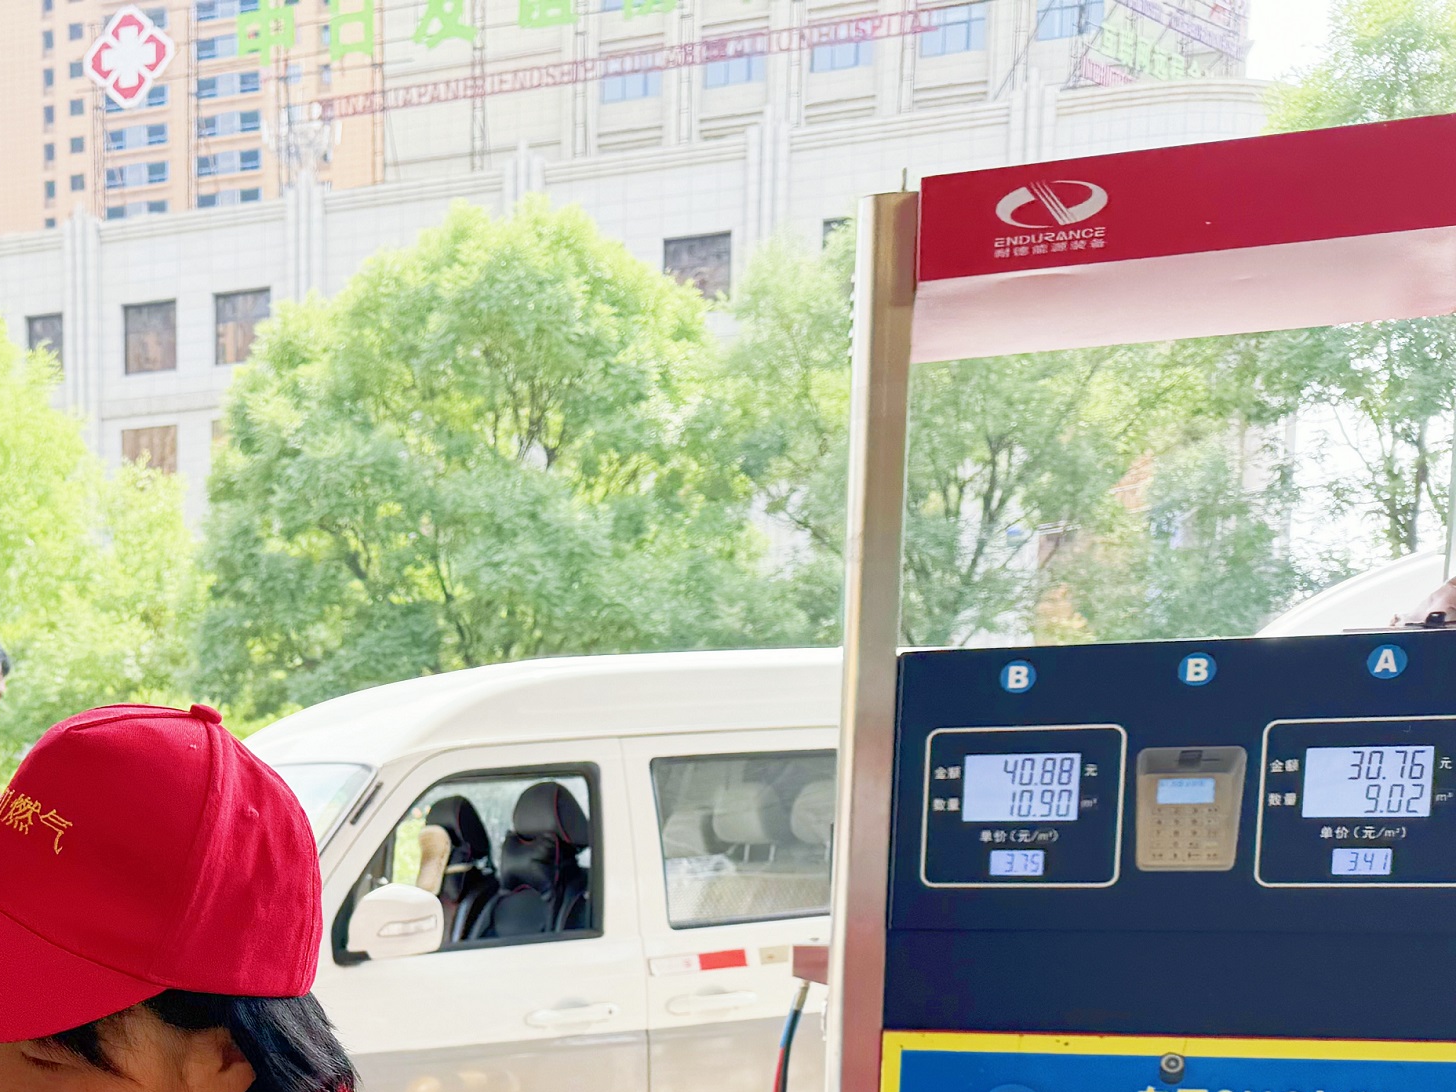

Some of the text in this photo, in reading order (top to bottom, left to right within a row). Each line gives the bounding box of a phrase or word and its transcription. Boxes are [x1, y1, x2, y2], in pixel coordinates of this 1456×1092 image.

[994, 227, 1106, 248] ENDURANCE
[1185, 657, 1209, 682] B
[1373, 649, 1398, 674] A
[1007, 666, 1029, 689] B
[934, 765, 962, 780] 金额
[1003, 757, 1075, 787] 40.88
[1084, 763, 1098, 777] 元
[1269, 758, 1300, 773] 金额
[1347, 750, 1426, 780] 30.76
[1439, 756, 1453, 770] 元
[932, 797, 960, 812] 数量
[1009, 788, 1073, 818] 10.90
[1268, 792, 1297, 807] 数量
[1363, 783, 1425, 814] 9.02
[1004, 853, 1042, 873] 3.75
[1347, 851, 1389, 872] 3.41
